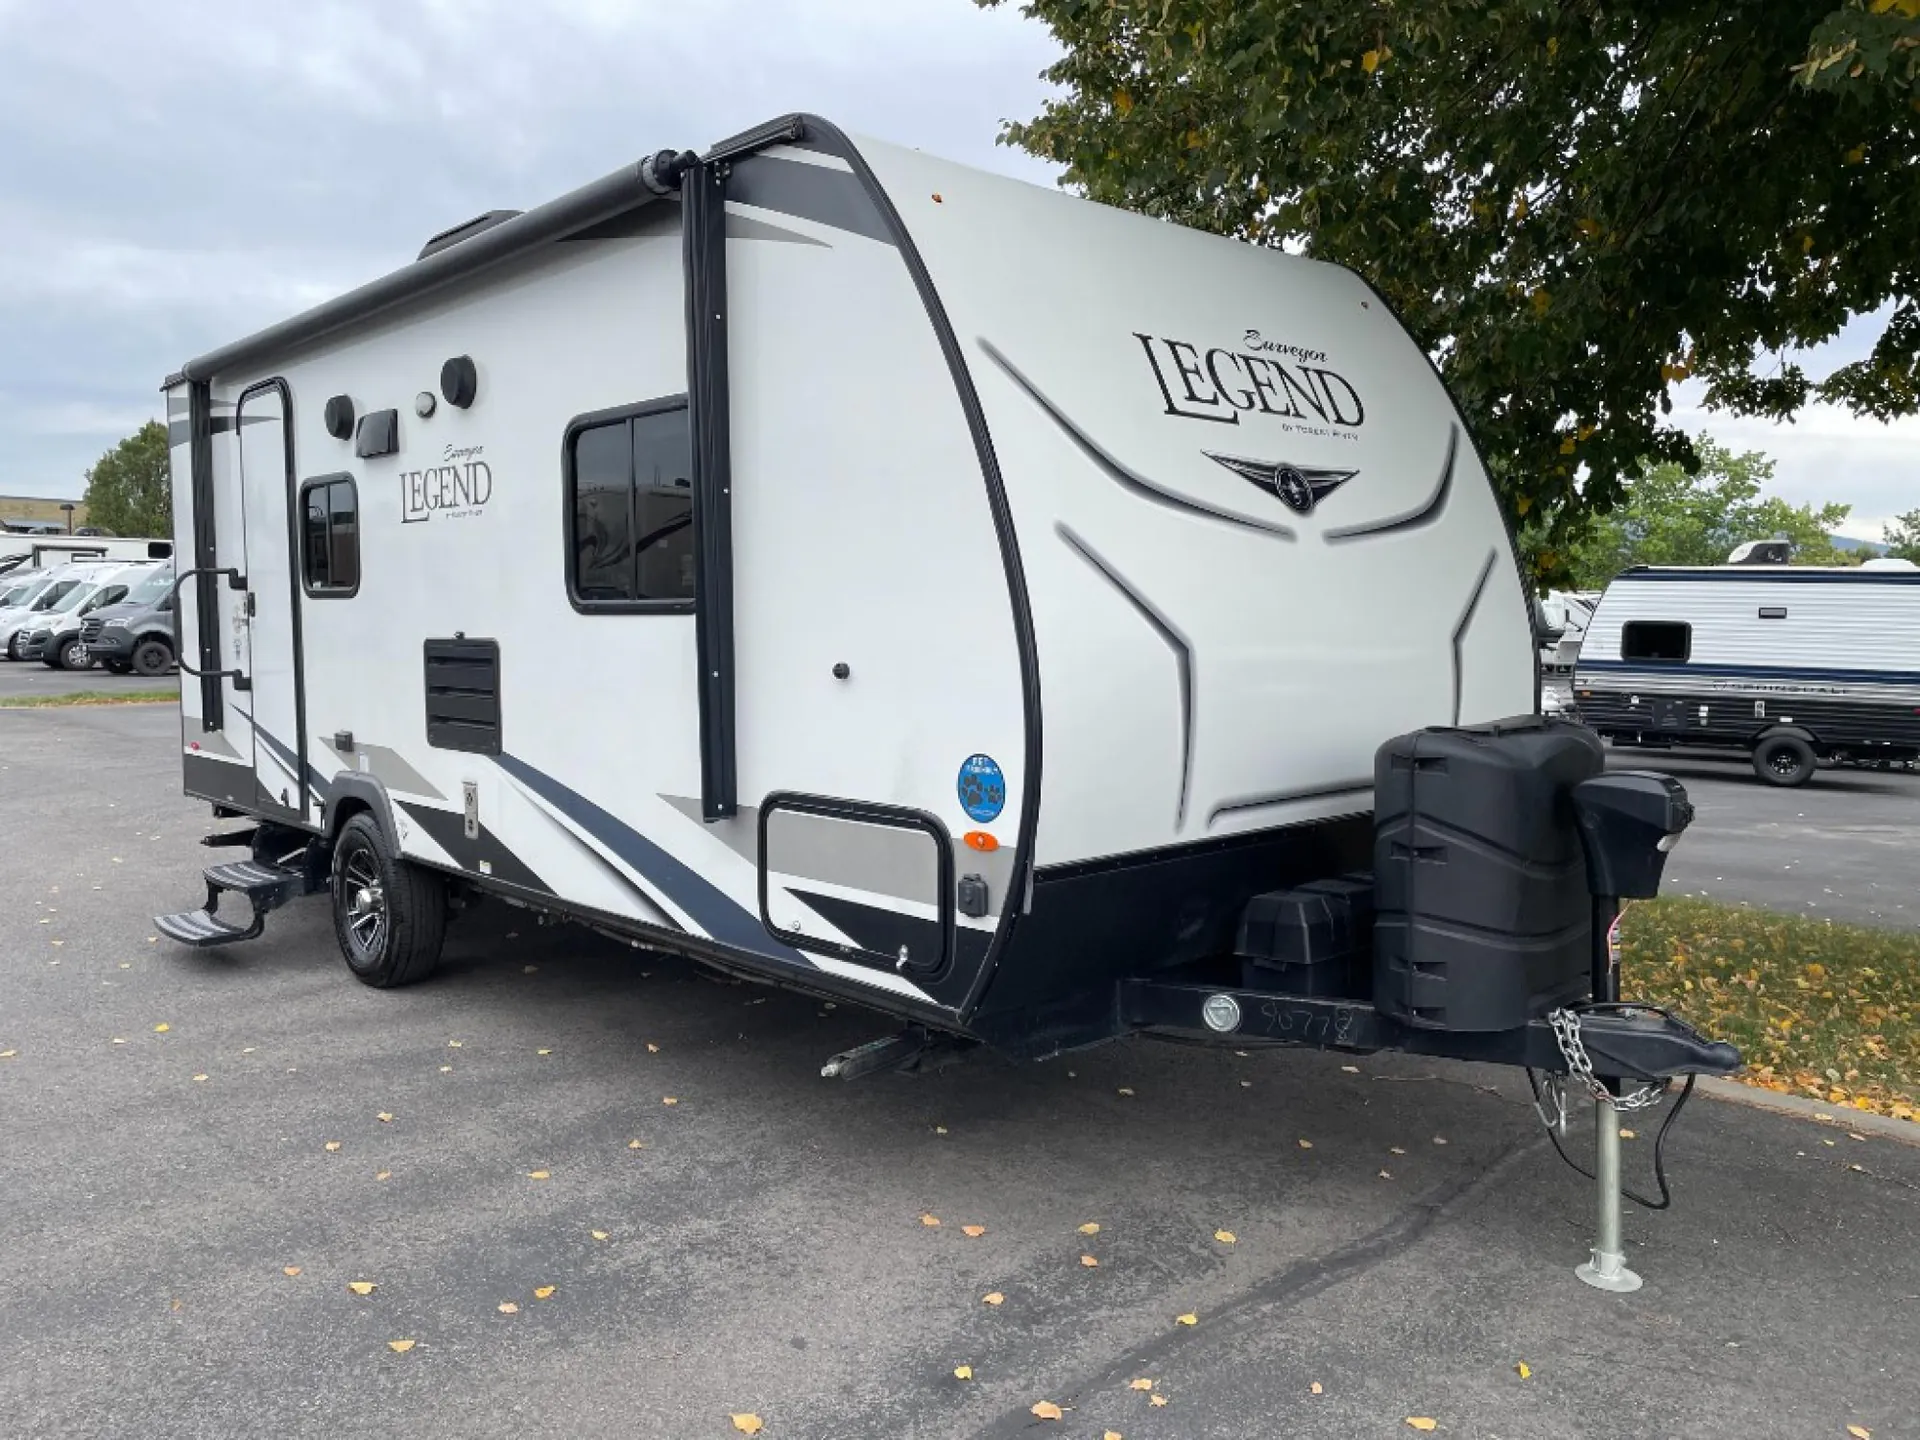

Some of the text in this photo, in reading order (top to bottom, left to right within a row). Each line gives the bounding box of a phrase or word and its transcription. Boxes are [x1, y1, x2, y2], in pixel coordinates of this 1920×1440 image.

[1243, 329, 1328, 362] Surveyor
[1132, 332, 1365, 427] LEGEND
[399, 461, 492, 523] LEGEND
